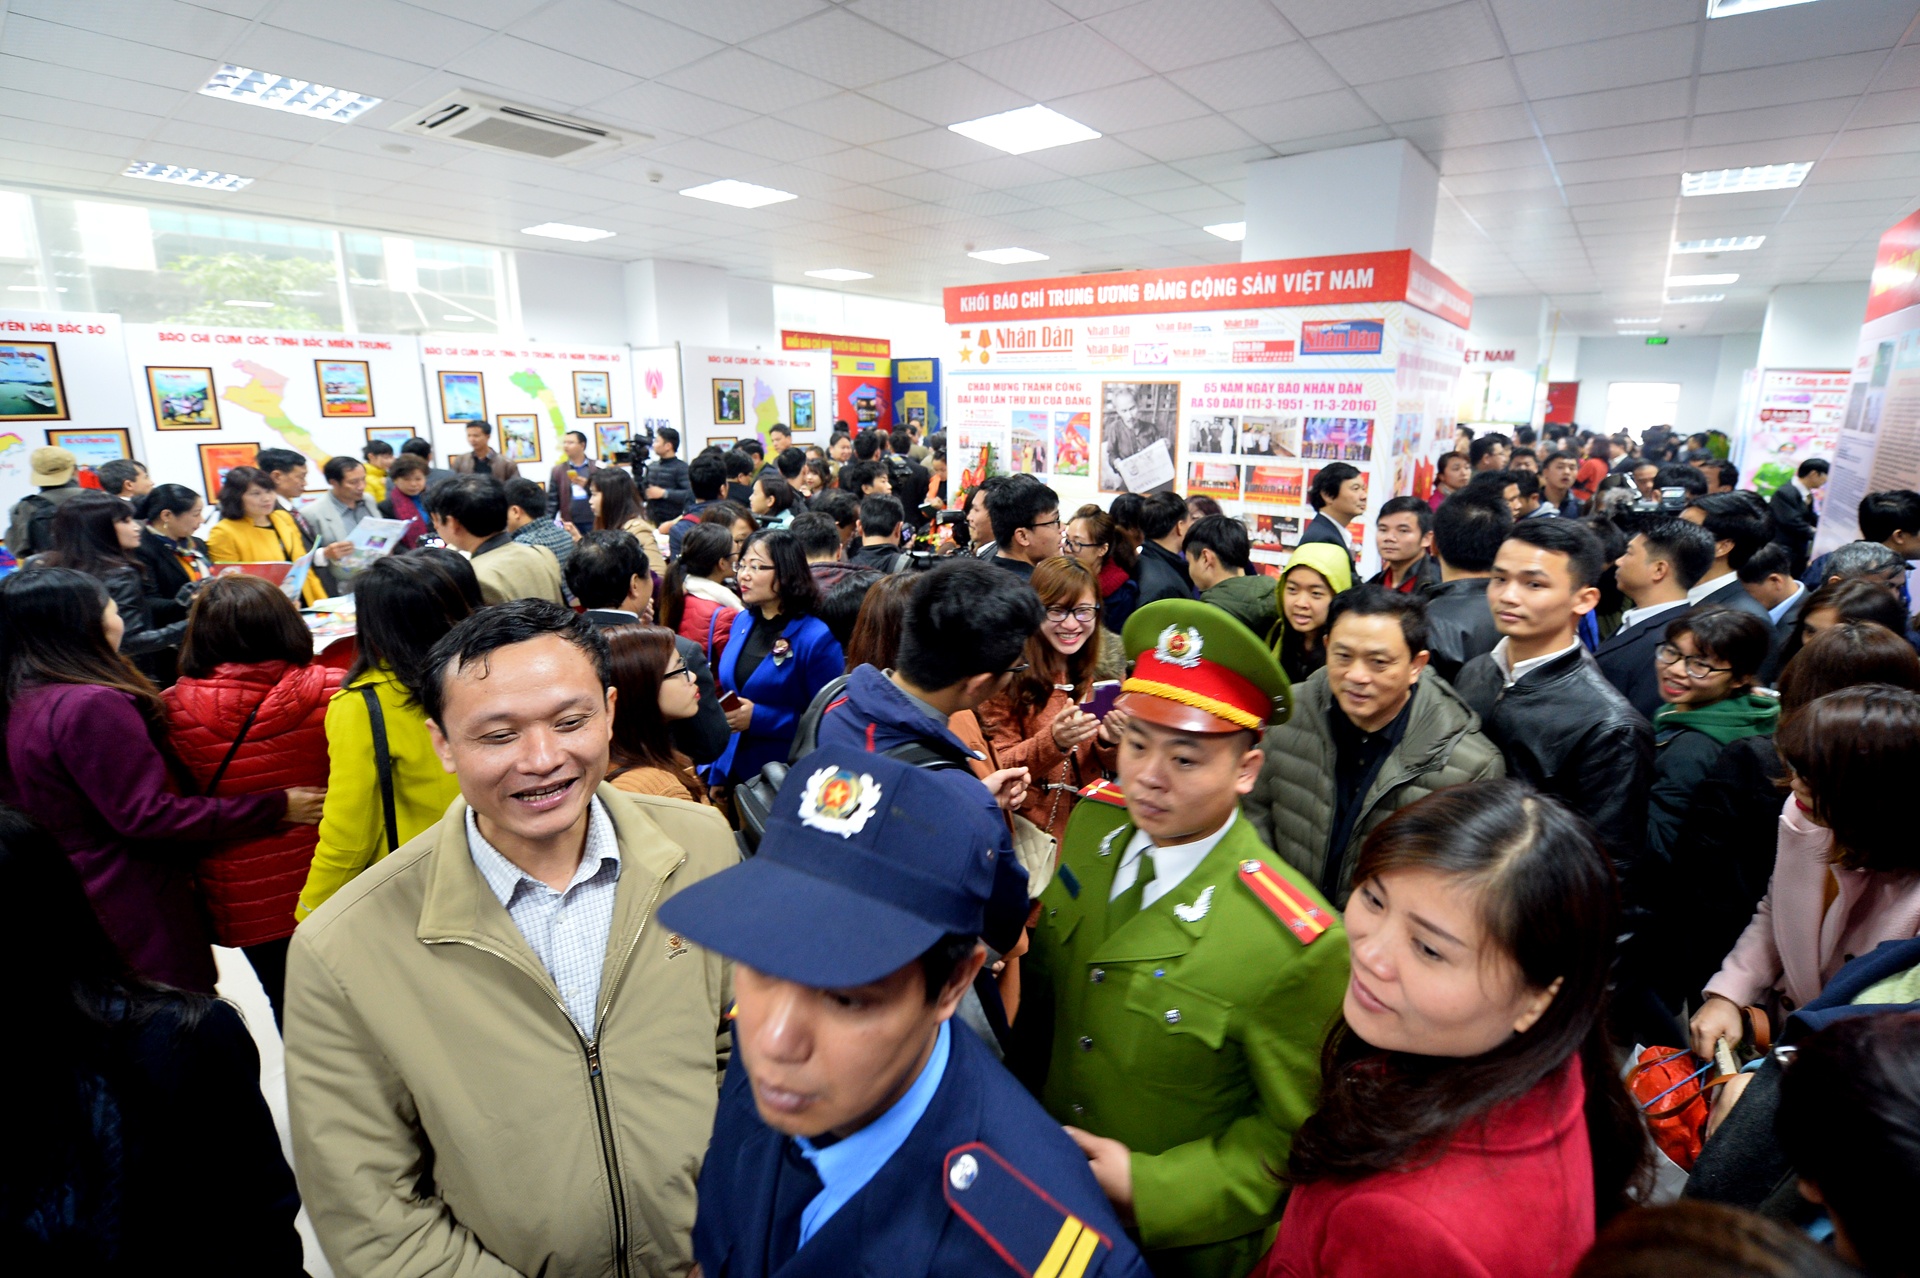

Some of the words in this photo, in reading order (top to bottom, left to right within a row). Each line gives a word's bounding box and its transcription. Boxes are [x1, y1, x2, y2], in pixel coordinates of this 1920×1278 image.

[960, 293, 990, 312] KHỐI
[993, 291, 1018, 310] BÁO
[1021, 288, 1044, 308] CHÍ
[1047, 287, 1094, 307] TRUNG
[1097, 284, 1139, 304] ƯƠNG
[1143, 279, 1187, 301] ĐẢNG
[1190, 277, 1237, 301] CỘNG
[1241, 272, 1277, 297] SẢN
[1283, 269, 1324, 295] VIỆT
[1329, 267, 1374, 291] NAM
[996, 327, 1036, 349] Nhân
[1042, 326, 1073, 348] Dân
[1304, 330, 1346, 350] Nhân
[1347, 329, 1380, 348] Dân
[1484, 349, 1516, 363] NAM
[1204, 382, 1217, 393] 65
[1190, 397, 1204, 408] RA
